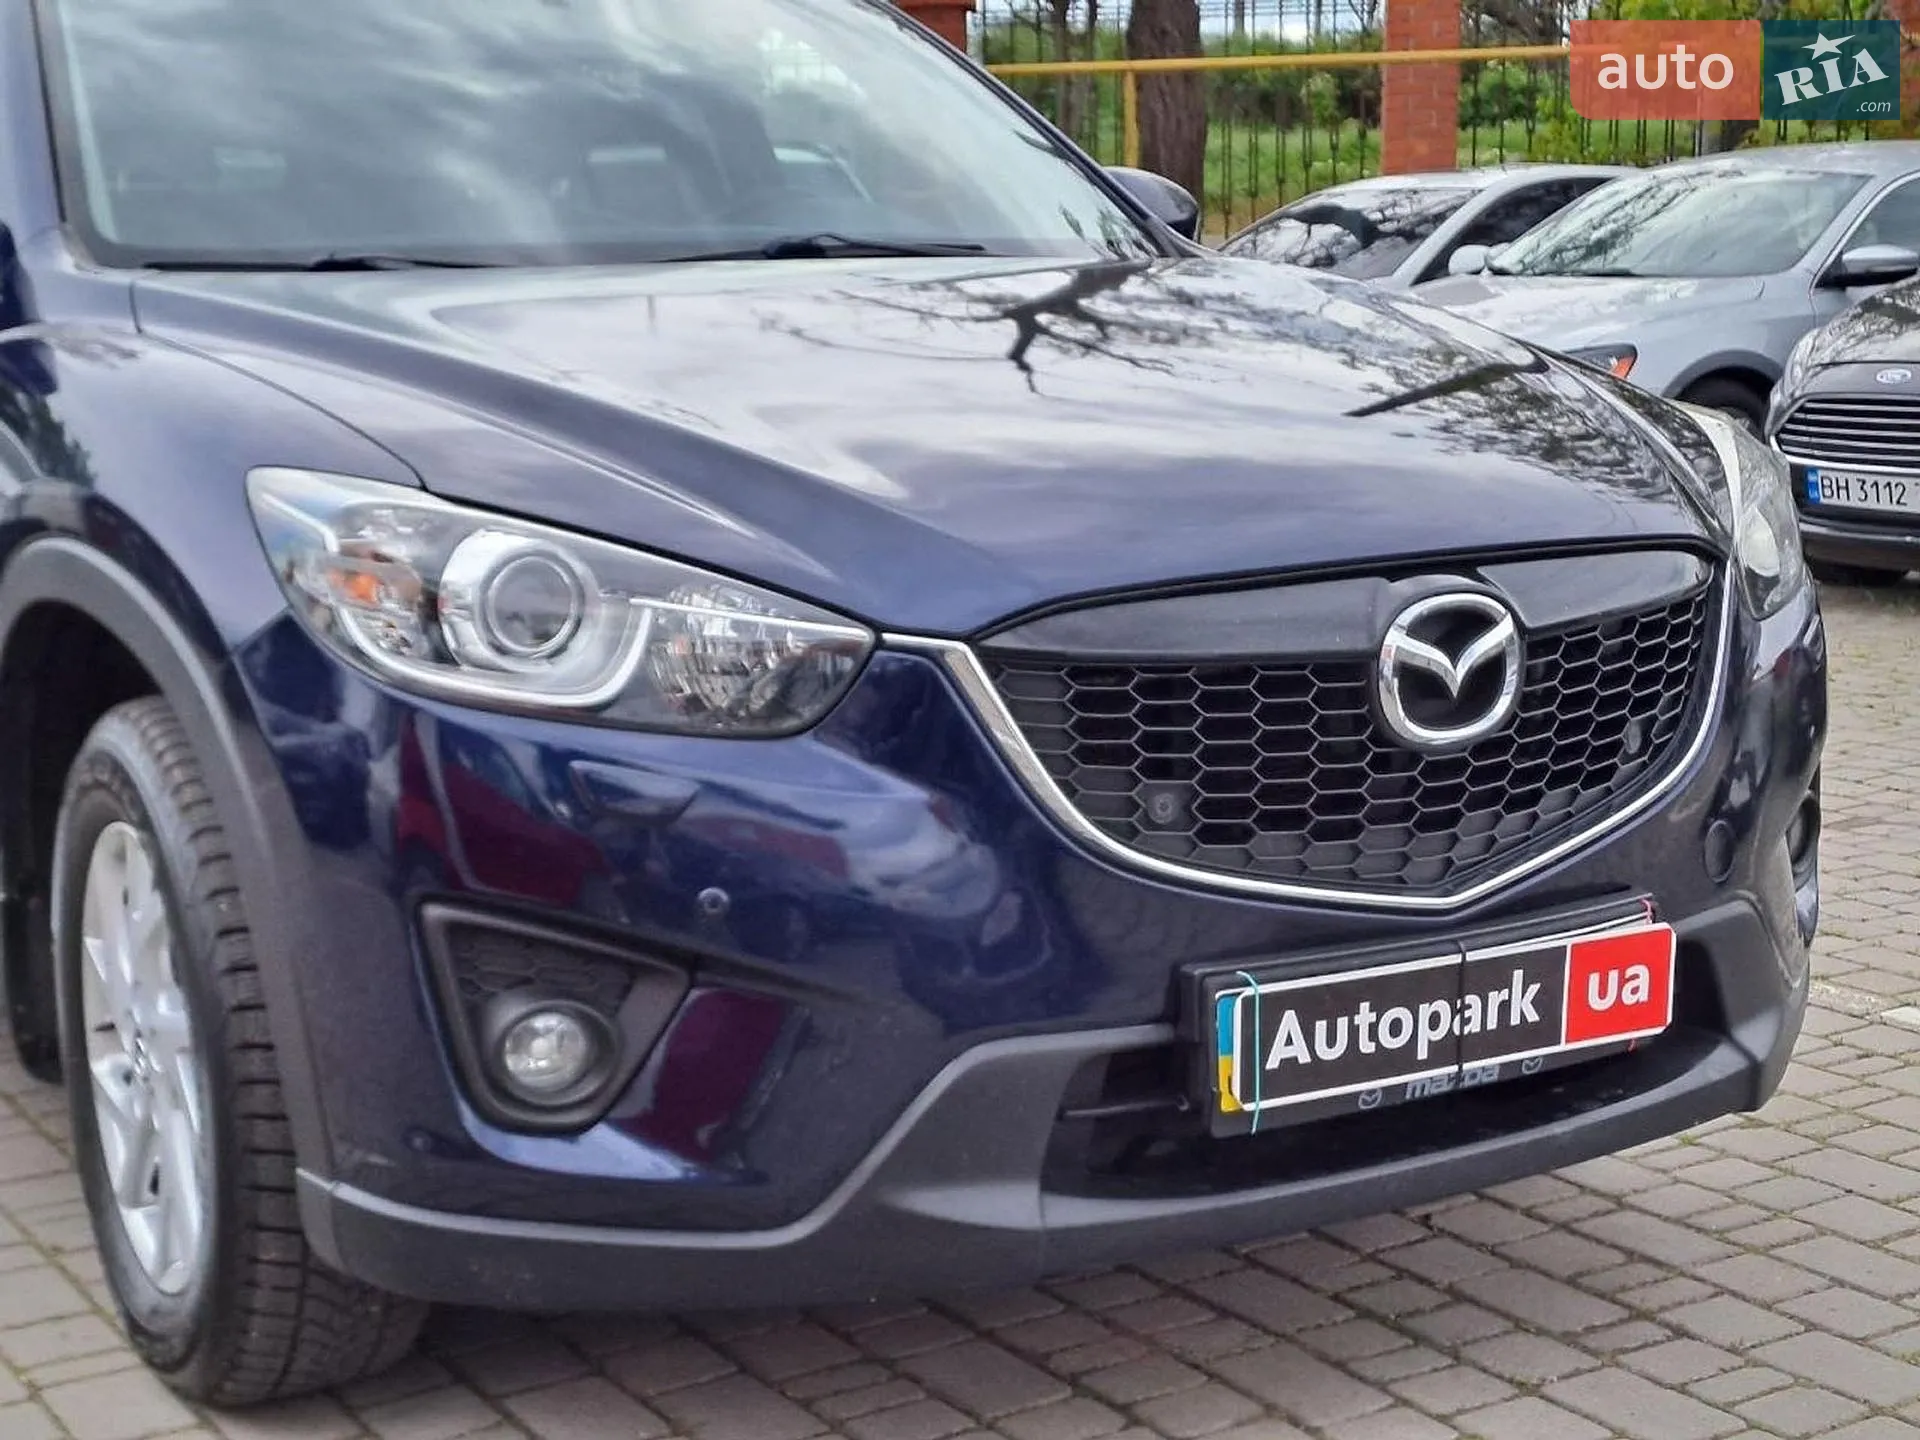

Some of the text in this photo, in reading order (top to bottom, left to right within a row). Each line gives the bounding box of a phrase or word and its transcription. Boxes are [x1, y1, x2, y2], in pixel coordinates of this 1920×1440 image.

[1821, 476, 1850, 501] BH
[1856, 478, 1908, 506] 3112
[1265, 964, 1650, 1070] Autopark ua
